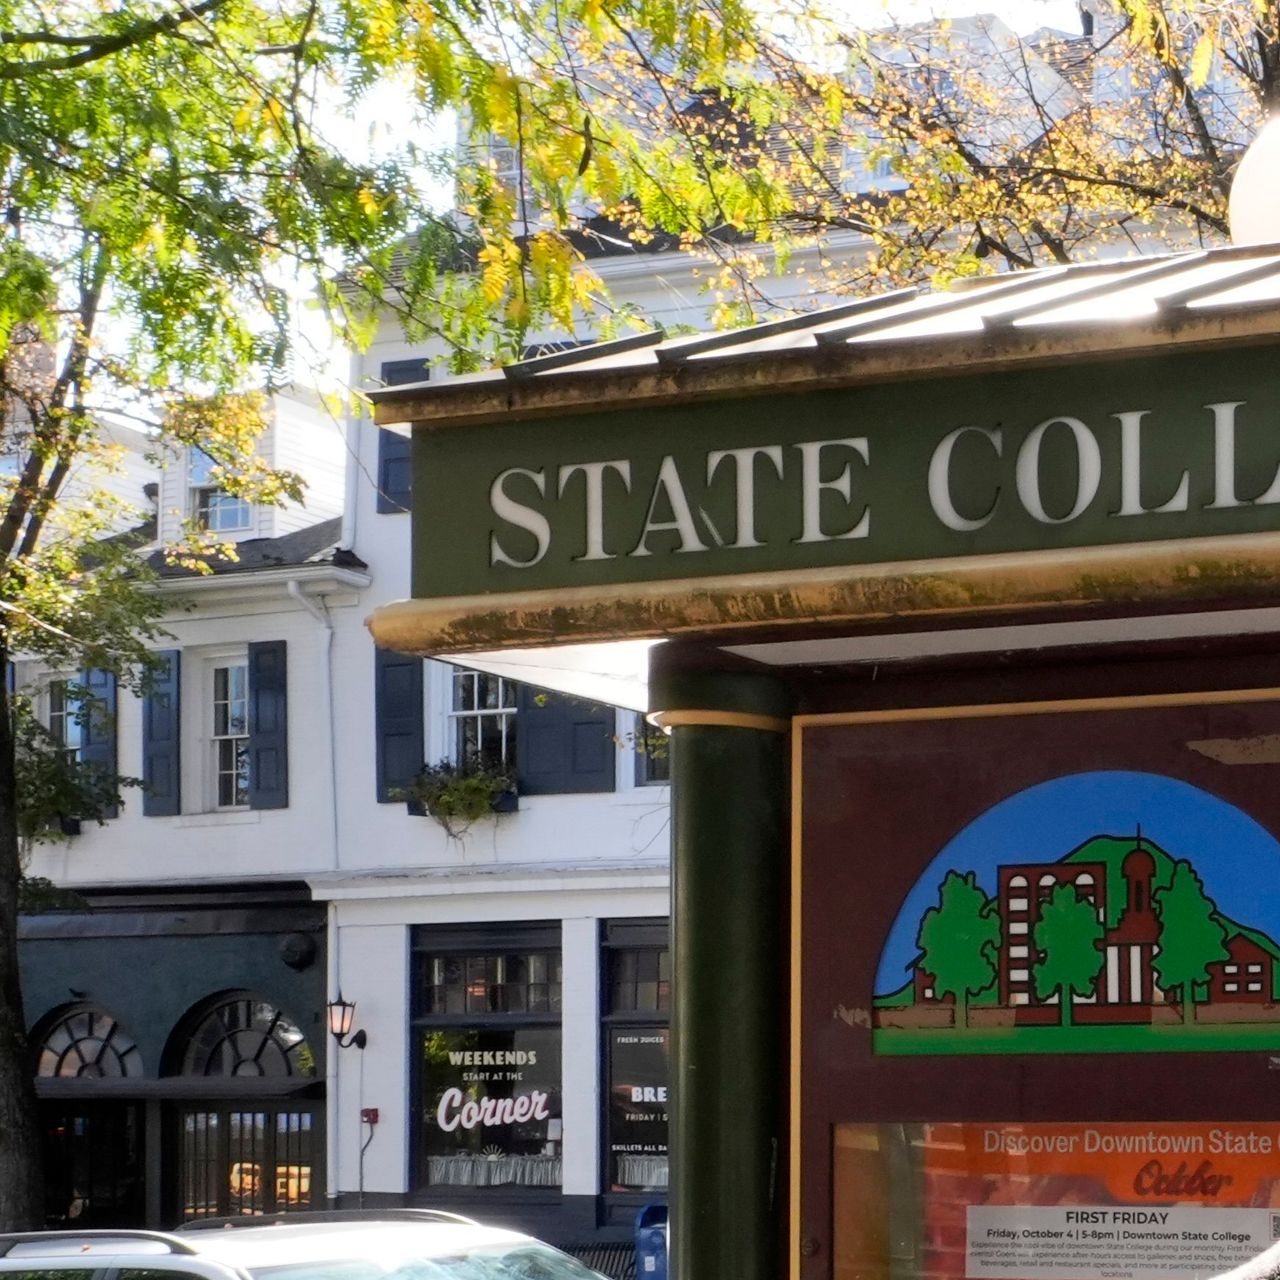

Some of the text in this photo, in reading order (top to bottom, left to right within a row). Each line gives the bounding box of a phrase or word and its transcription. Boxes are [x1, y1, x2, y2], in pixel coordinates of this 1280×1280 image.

[489, 437, 870, 568] STATE
[448, 1051, 537, 1065] WEEKENDS
[463, 1072, 523, 1080] START AT THE
[631, 1087, 667, 1102] BRE
[437, 1087, 549, 1132] Corner
[984, 1129, 1079, 1152] Discover
[1085, 1129, 1203, 1153] Downtown
[1209, 1129, 1272, 1153] State
[1065, 1212, 1169, 1225] FIRST FRIDAY
[987, 1229, 1019, 1240] Friday,
[1022, 1229, 1063, 1239] October
[1081, 1230, 1114, 1240] 5-8pm
[1123, 1231, 1179, 1240] Downtown
[1181, 1231, 1208, 1241] State
[1212, 1232, 1251, 1242] College
